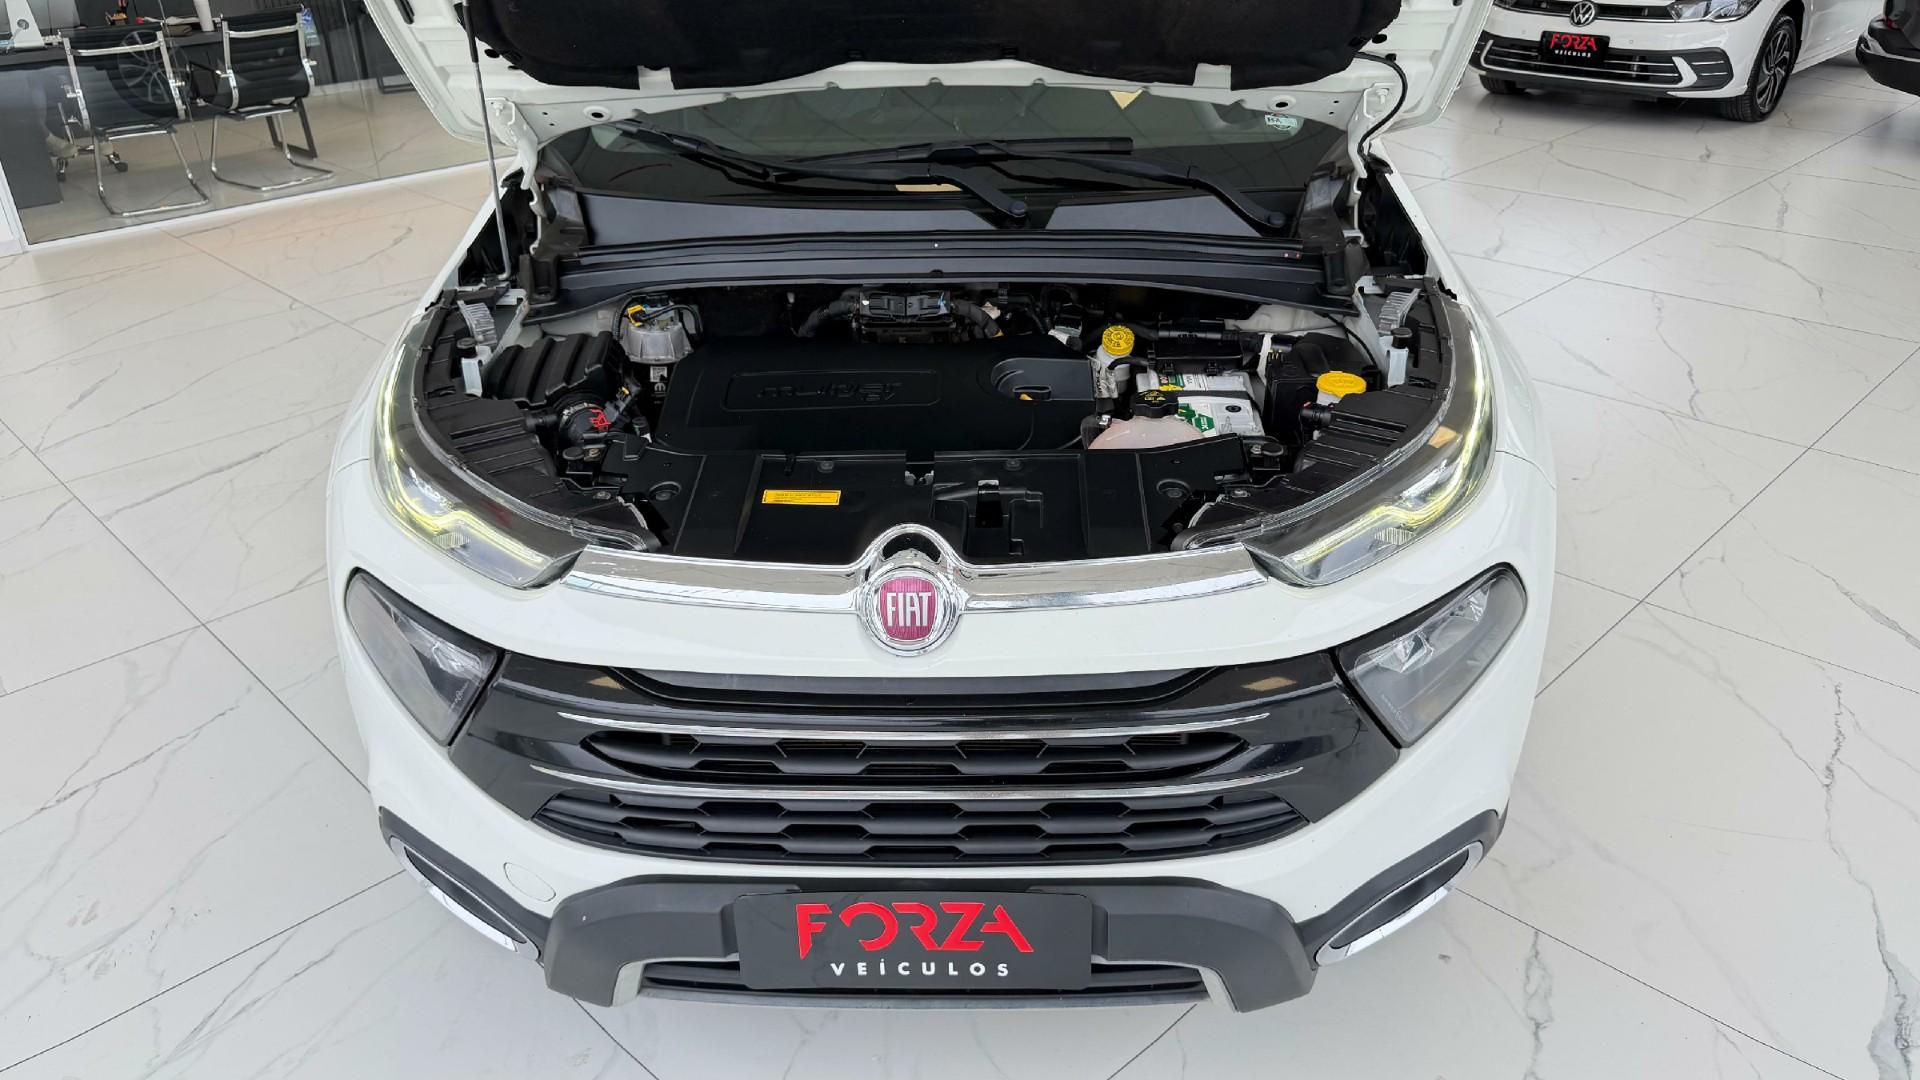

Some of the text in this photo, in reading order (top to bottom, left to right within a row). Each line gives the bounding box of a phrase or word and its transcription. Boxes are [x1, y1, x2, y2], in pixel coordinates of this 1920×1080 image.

[1550, 33, 1597, 51] FORZA
[886, 592, 932, 627] FIAT
[795, 901, 1035, 960] FORZA
[830, 958, 1009, 977] VEÍCULOS
